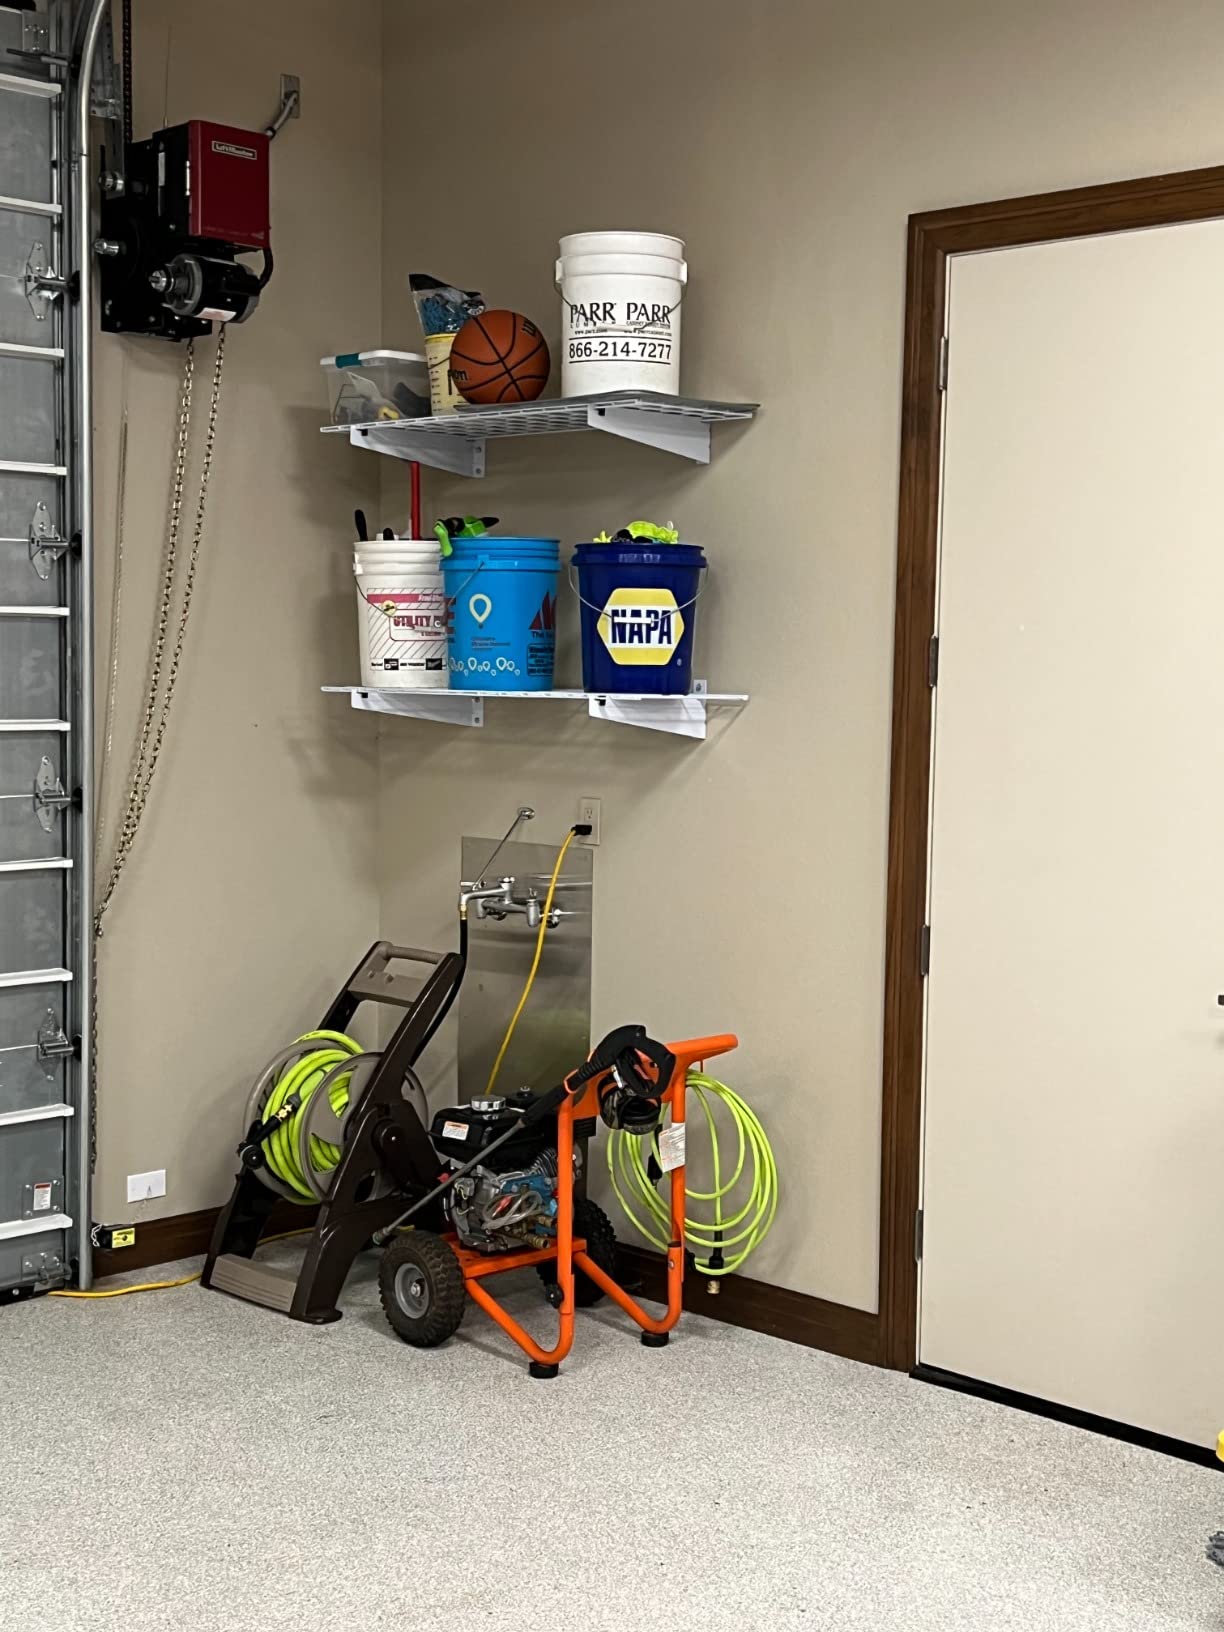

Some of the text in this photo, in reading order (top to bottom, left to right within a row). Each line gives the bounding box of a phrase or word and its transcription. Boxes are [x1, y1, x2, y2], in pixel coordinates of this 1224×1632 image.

[570, 302, 616, 324] PARR
[626, 302, 671, 325] PARR
[569, 341, 671, 359] 866-214-7277
[611, 608, 672, 644] NAPA
